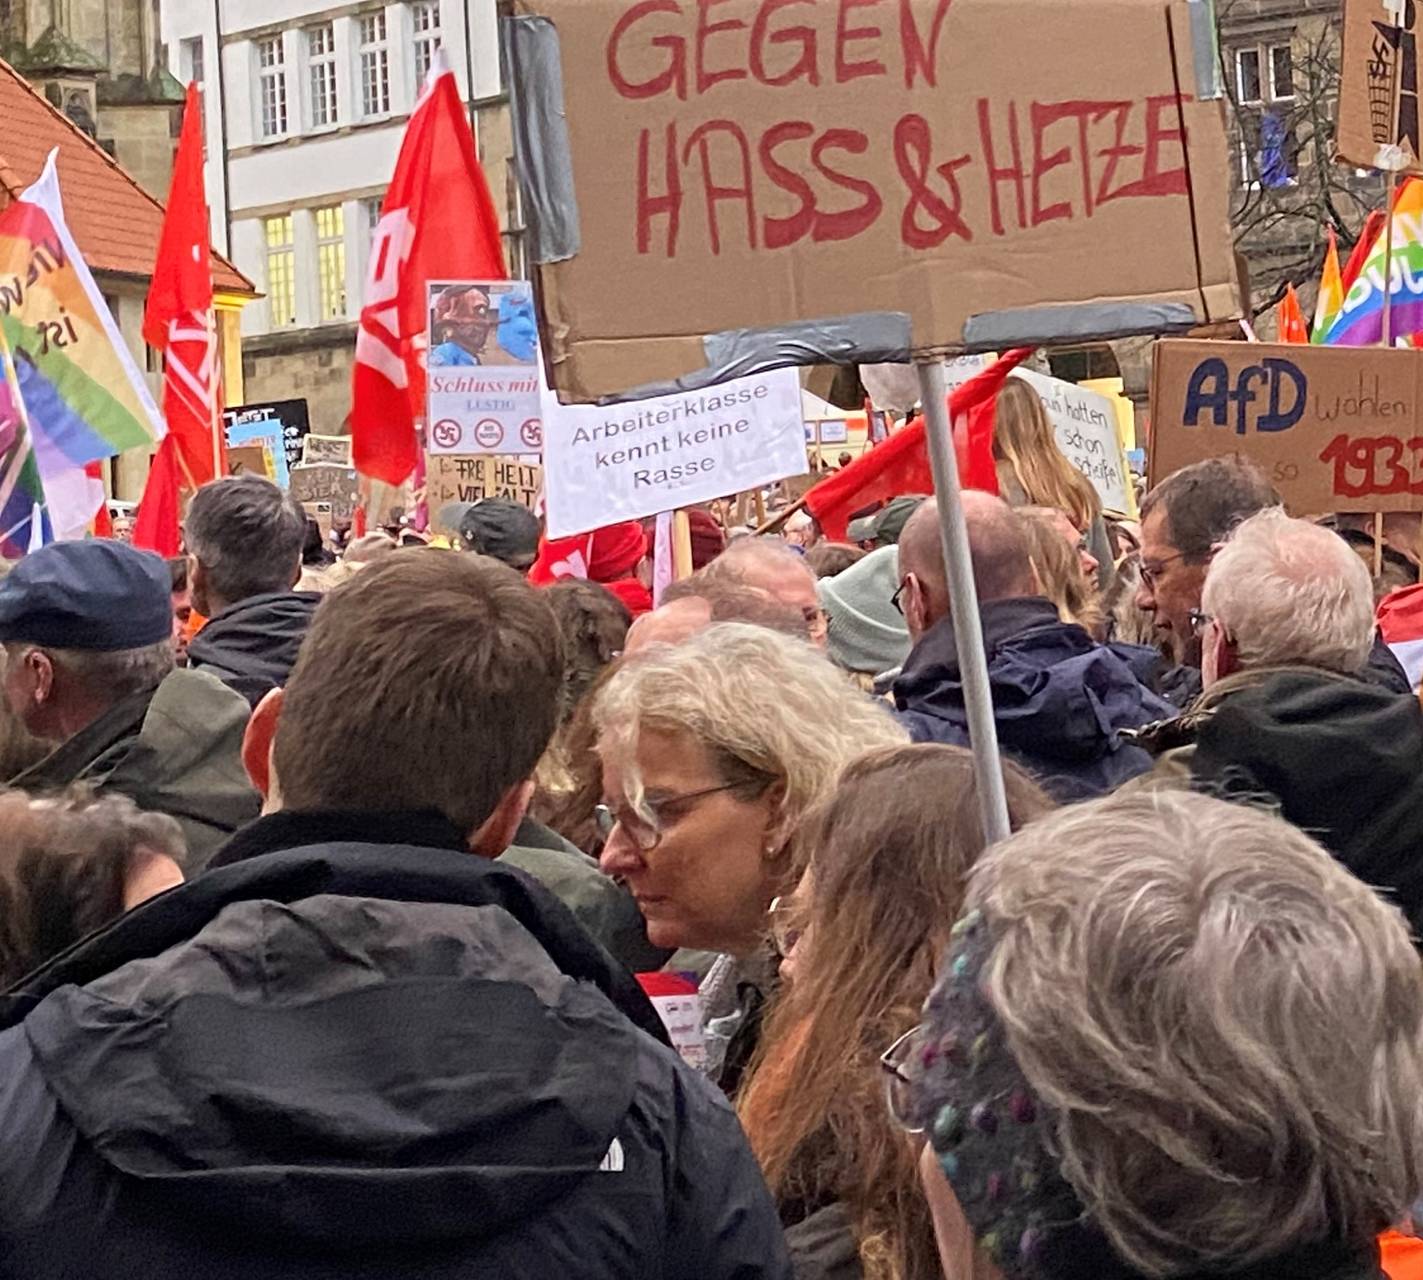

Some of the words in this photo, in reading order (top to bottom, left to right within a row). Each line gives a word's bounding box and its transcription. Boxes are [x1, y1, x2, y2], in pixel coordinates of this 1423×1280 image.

[608, 0, 951, 99] GEGEN
[431, 376, 503, 394] Schluss
[508, 376, 538, 393] mit
[1183, 357, 1307, 434] AfD
[571, 383, 769, 446] Arbeiterklasse
[594, 436, 674, 470] kennt
[678, 418, 750, 448] keine
[453, 457, 538, 488] FREHEIT
[633, 456, 716, 489] Rasse
